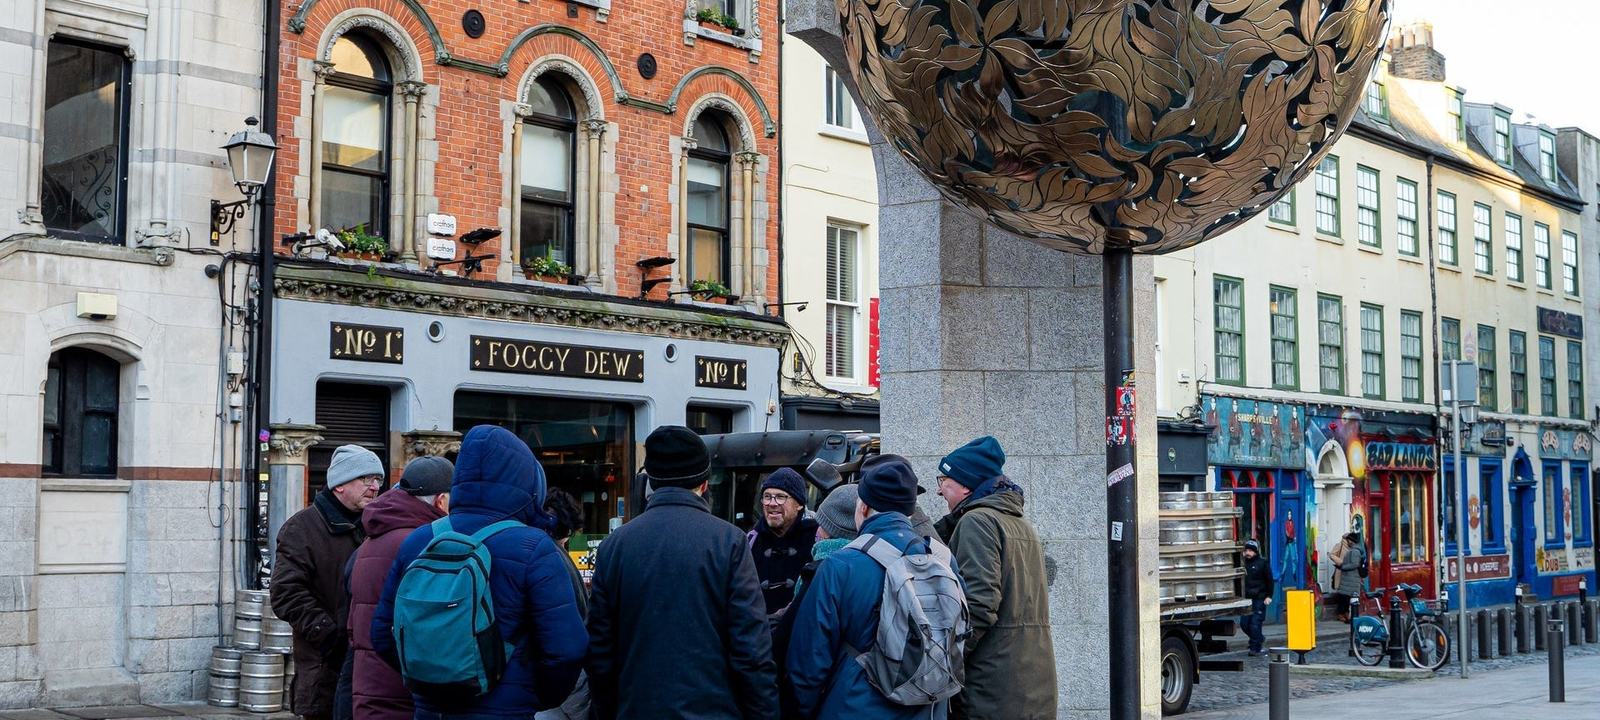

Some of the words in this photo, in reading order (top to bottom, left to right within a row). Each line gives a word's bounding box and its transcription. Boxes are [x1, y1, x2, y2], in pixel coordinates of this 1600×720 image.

[384, 332, 392, 358] 1
[488, 341, 571, 372] FOGGY
[584, 350, 631, 376] DEW
[733, 364, 739, 385] 1
